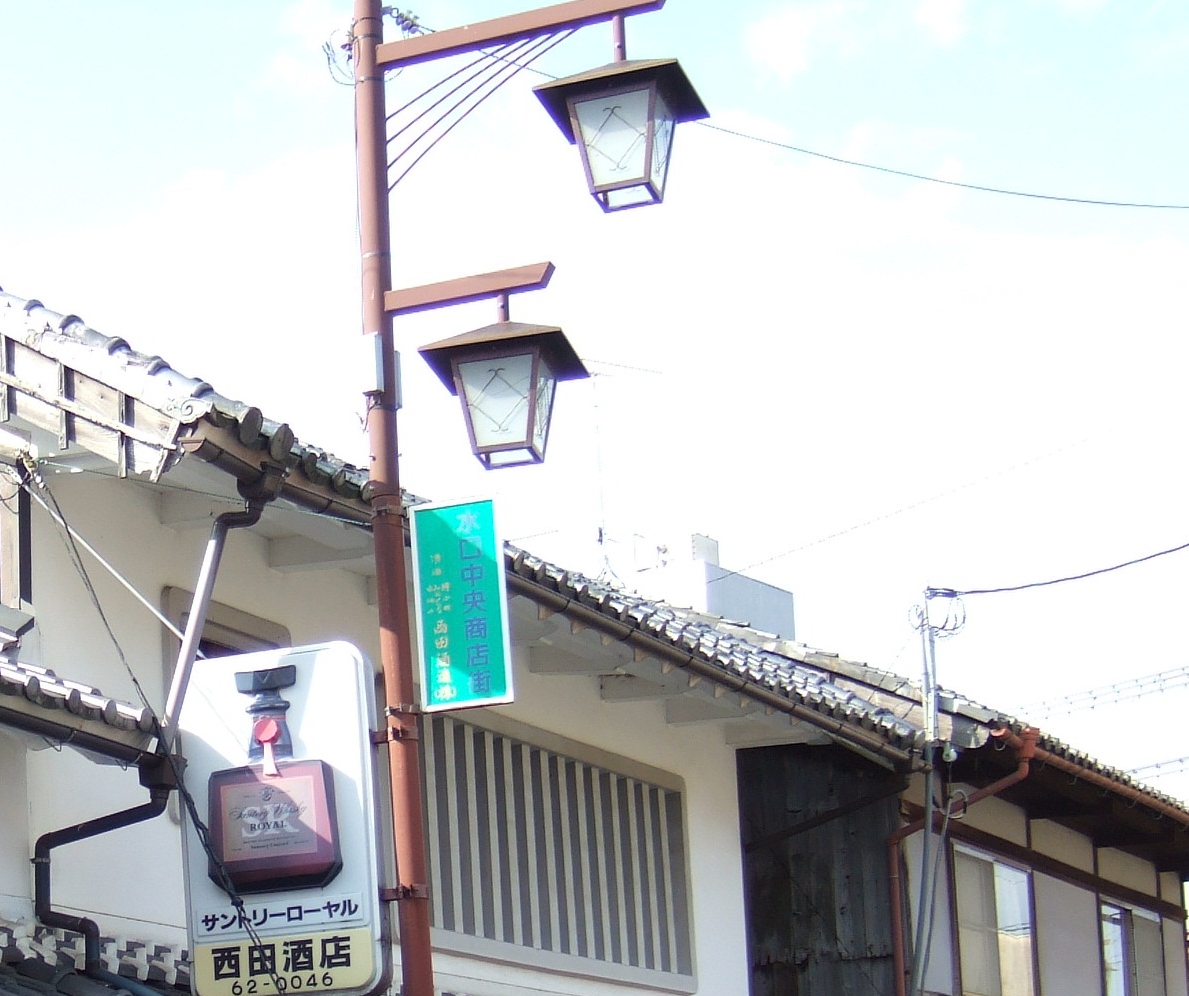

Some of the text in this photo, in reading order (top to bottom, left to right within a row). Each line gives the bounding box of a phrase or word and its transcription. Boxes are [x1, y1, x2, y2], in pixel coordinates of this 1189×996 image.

[455, 511, 491, 693] 水口中央商店街
[250, 821, 287, 832] ROYAL
[202, 899, 359, 931] サントリーローヤル
[212, 936, 351, 980] 西田酒店
[232, 972, 333, 996] 62-0046
